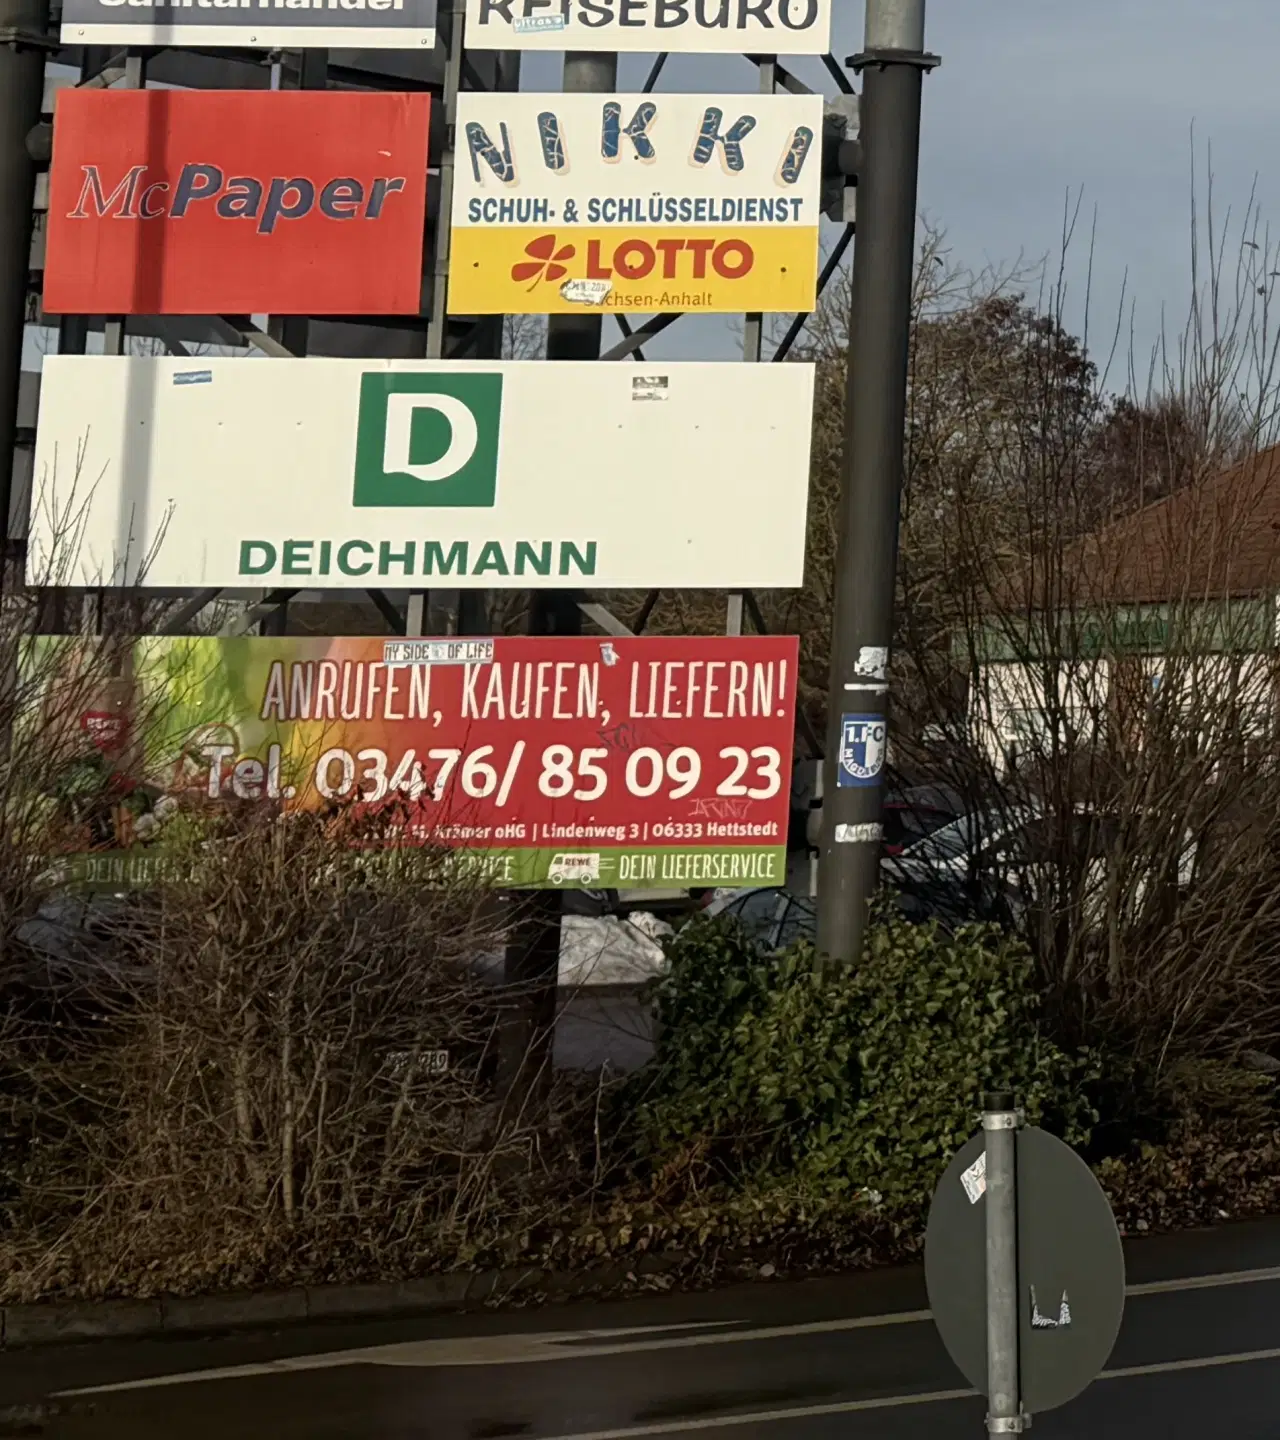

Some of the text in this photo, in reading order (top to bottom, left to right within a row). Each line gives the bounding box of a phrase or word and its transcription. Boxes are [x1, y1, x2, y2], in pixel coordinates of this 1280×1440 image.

[465, 101, 814, 188] NIKKI
[66, 162, 407, 236] McPaper
[467, 192, 804, 223] SCHUH- & SCHLÜSSELDIENST
[586, 238, 755, 280] LOTTO
[238, 538, 598, 577] DEICHMANN
[447, 643, 462, 659] OF
[466, 642, 493, 658] LIFE
[261, 659, 788, 727] ANRUFEN, KAUFEN, LIEFERN!
[201, 739, 782, 807] Tel. 03476/ 85 09 23
[495, 823, 526, 839] oHG
[542, 822, 626, 841] Lindenweg
[629, 823, 639, 838] 3
[652, 822, 703, 838] 06333
[706, 821, 779, 837] Hettstedt
[619, 852, 776, 881] DEIN LIEFERSERVICE
